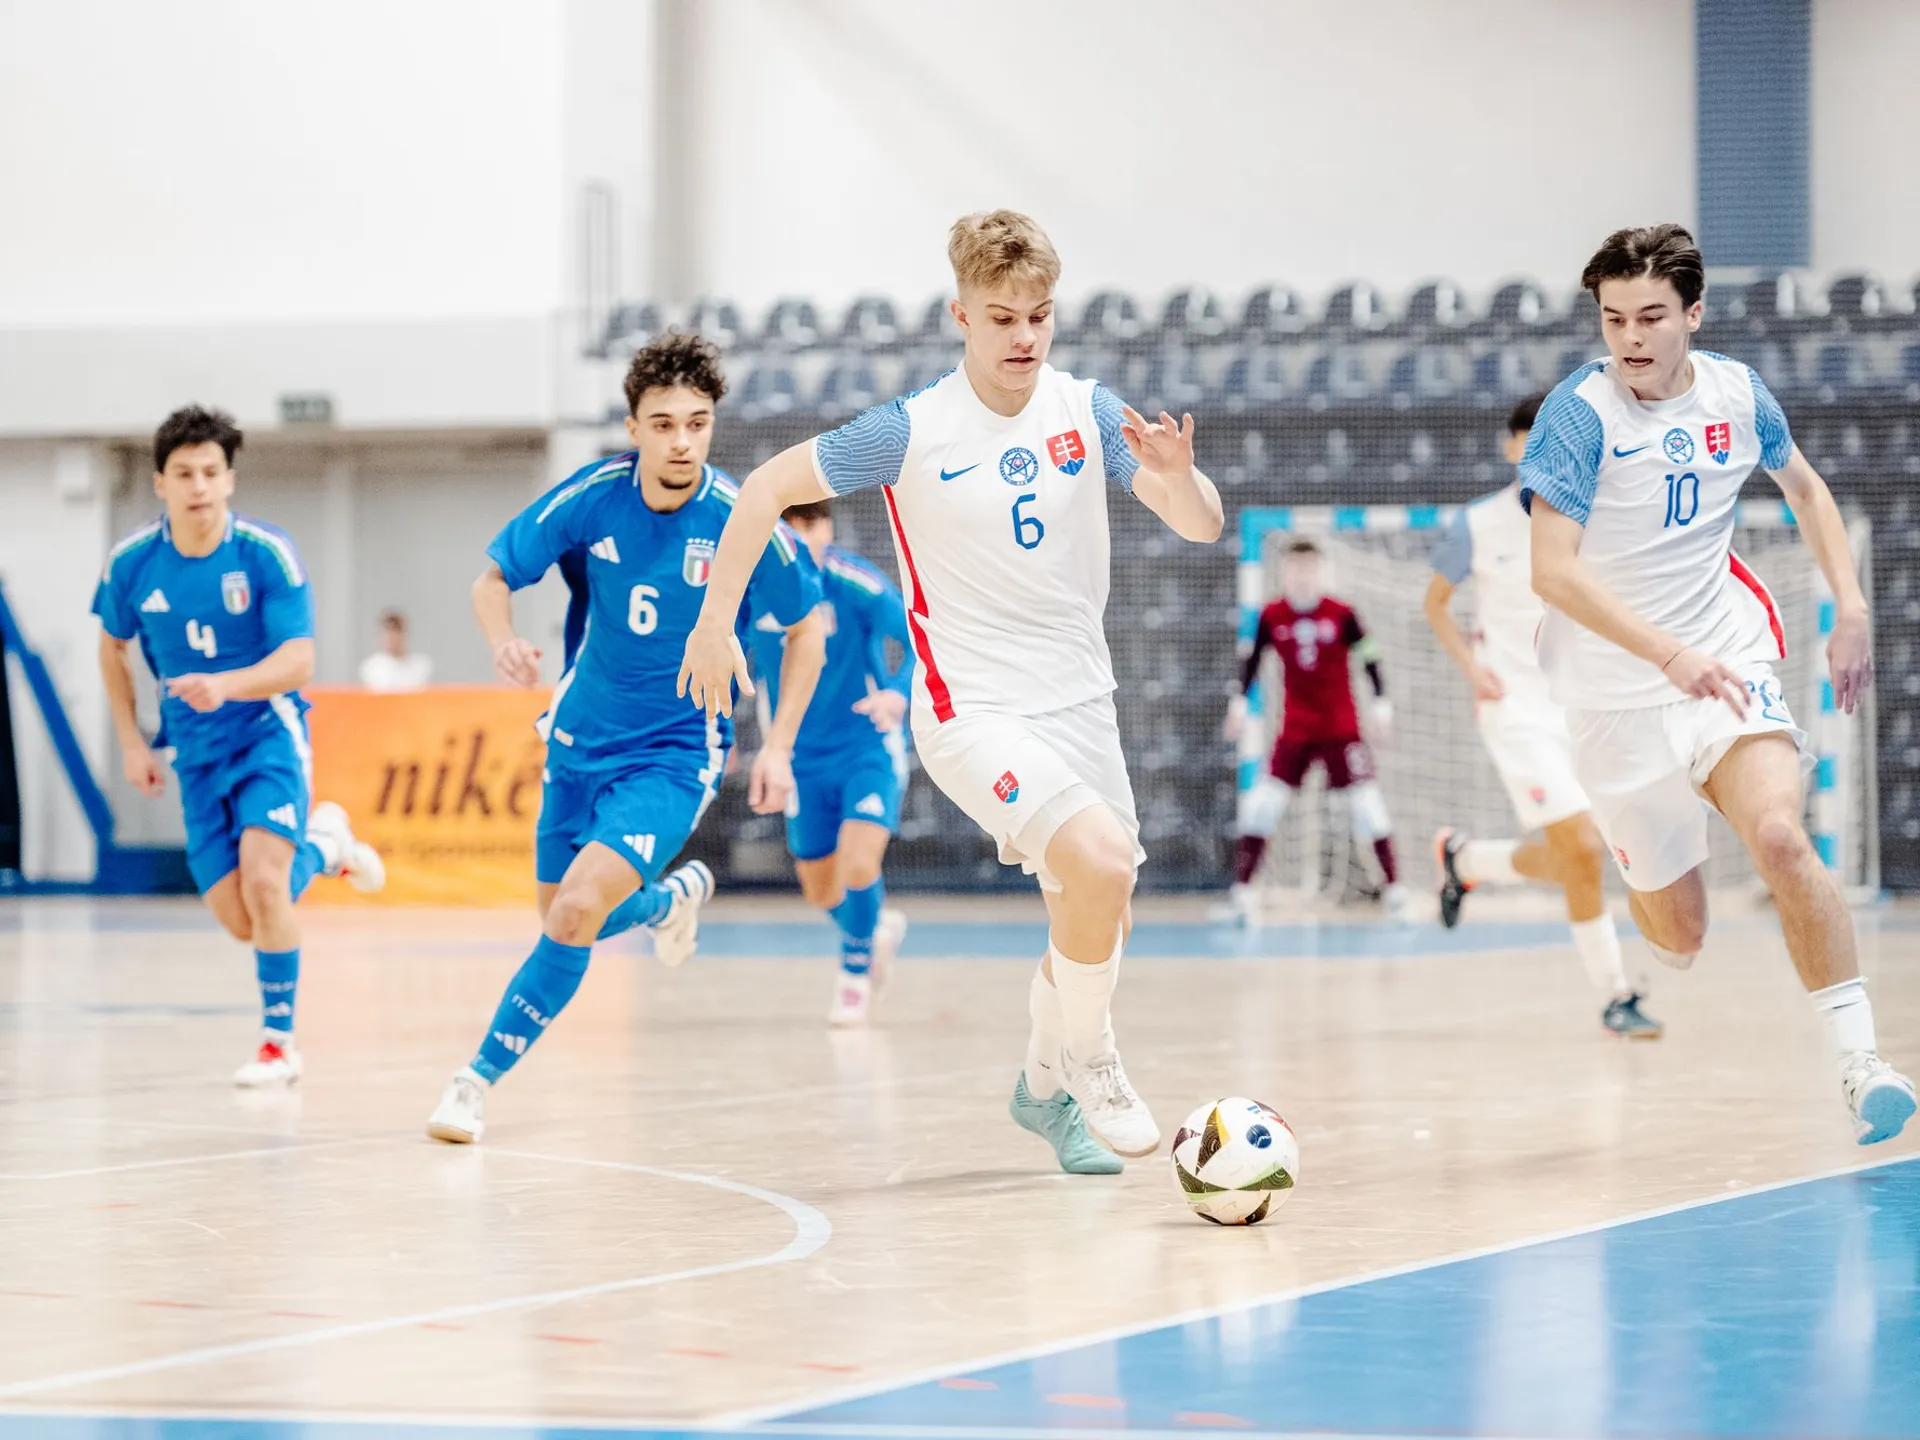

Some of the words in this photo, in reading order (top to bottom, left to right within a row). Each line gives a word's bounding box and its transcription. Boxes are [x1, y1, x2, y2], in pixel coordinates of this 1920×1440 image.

[1012, 493, 1044, 550] 6
[1664, 472, 1700, 528] 10
[628, 584, 660, 636] 6
[185, 618, 217, 659] 4
